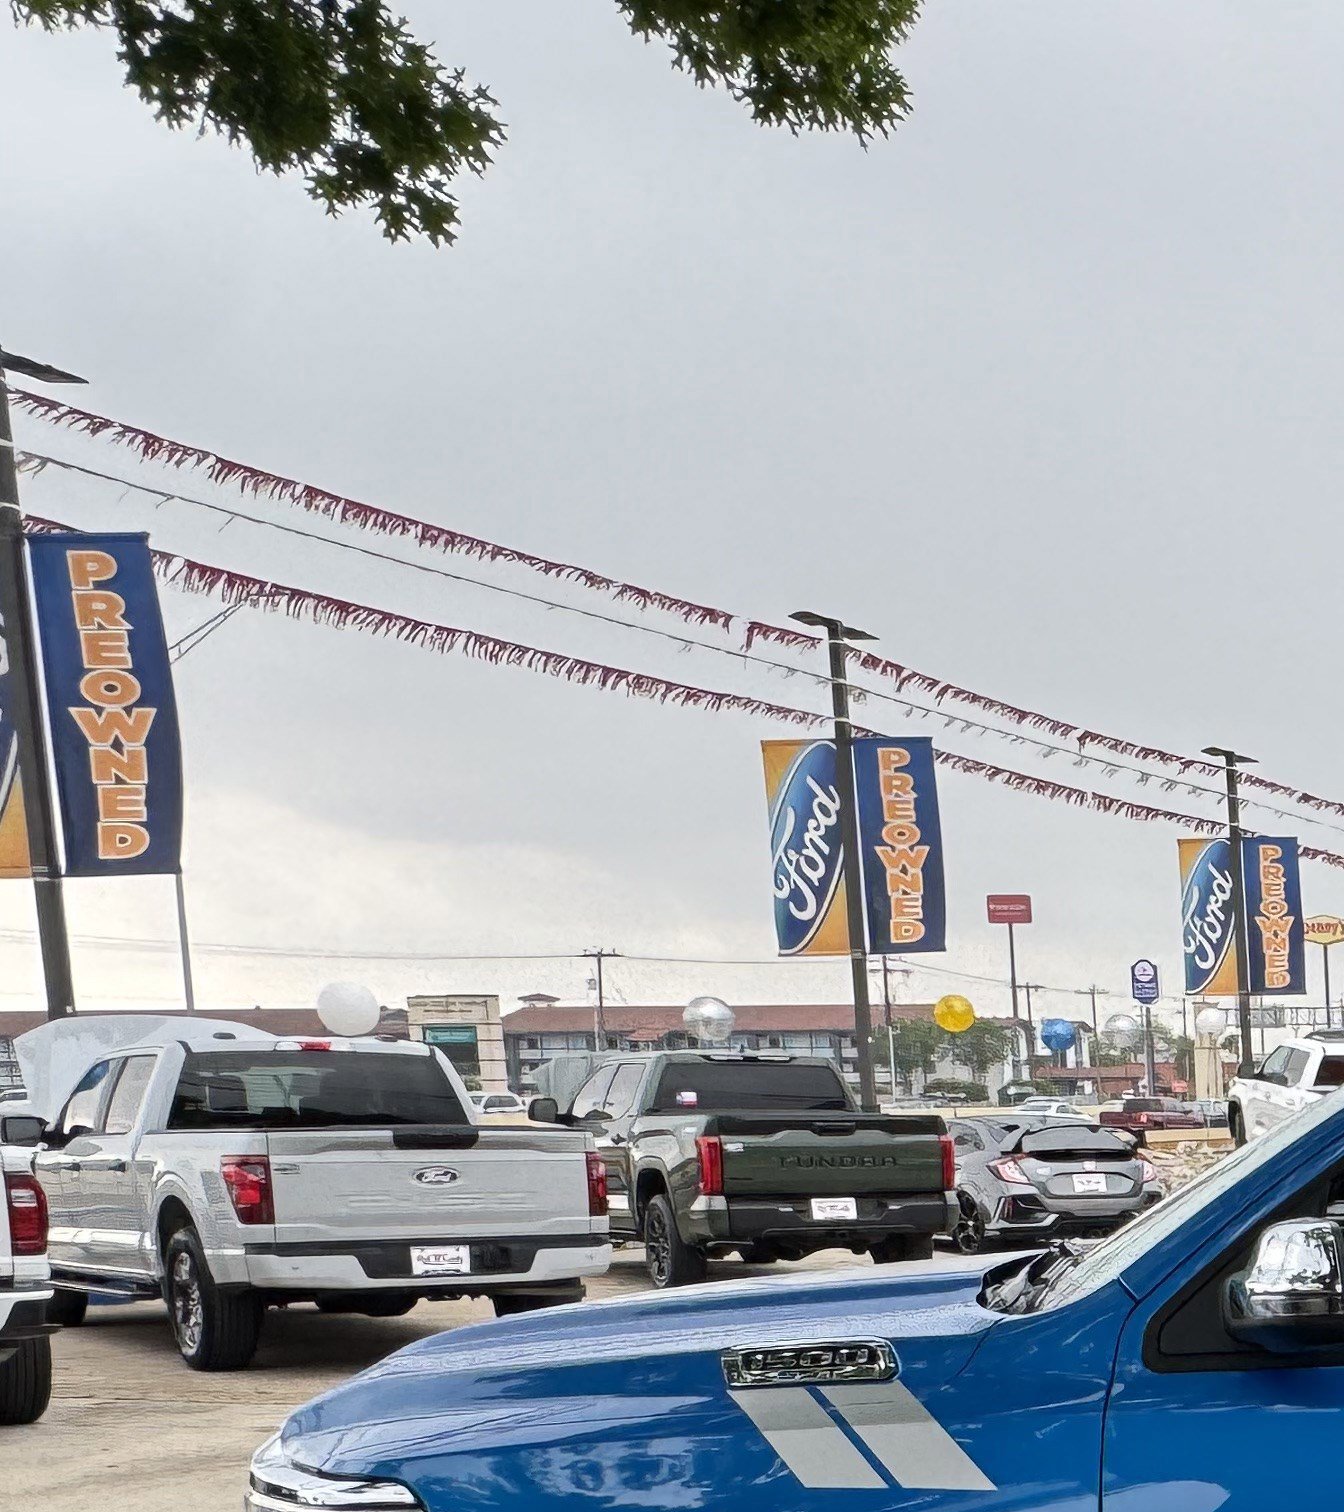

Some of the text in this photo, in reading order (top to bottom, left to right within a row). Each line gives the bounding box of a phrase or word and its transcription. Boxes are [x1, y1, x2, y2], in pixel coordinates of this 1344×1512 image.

[66, 550, 156, 859] PREOWNED
[774, 776, 840, 920] Ford
[874, 747, 930, 943] PREOWNED
[1183, 863, 1233, 969] Ford
[1254, 844, 1294, 988] PREOWNED
